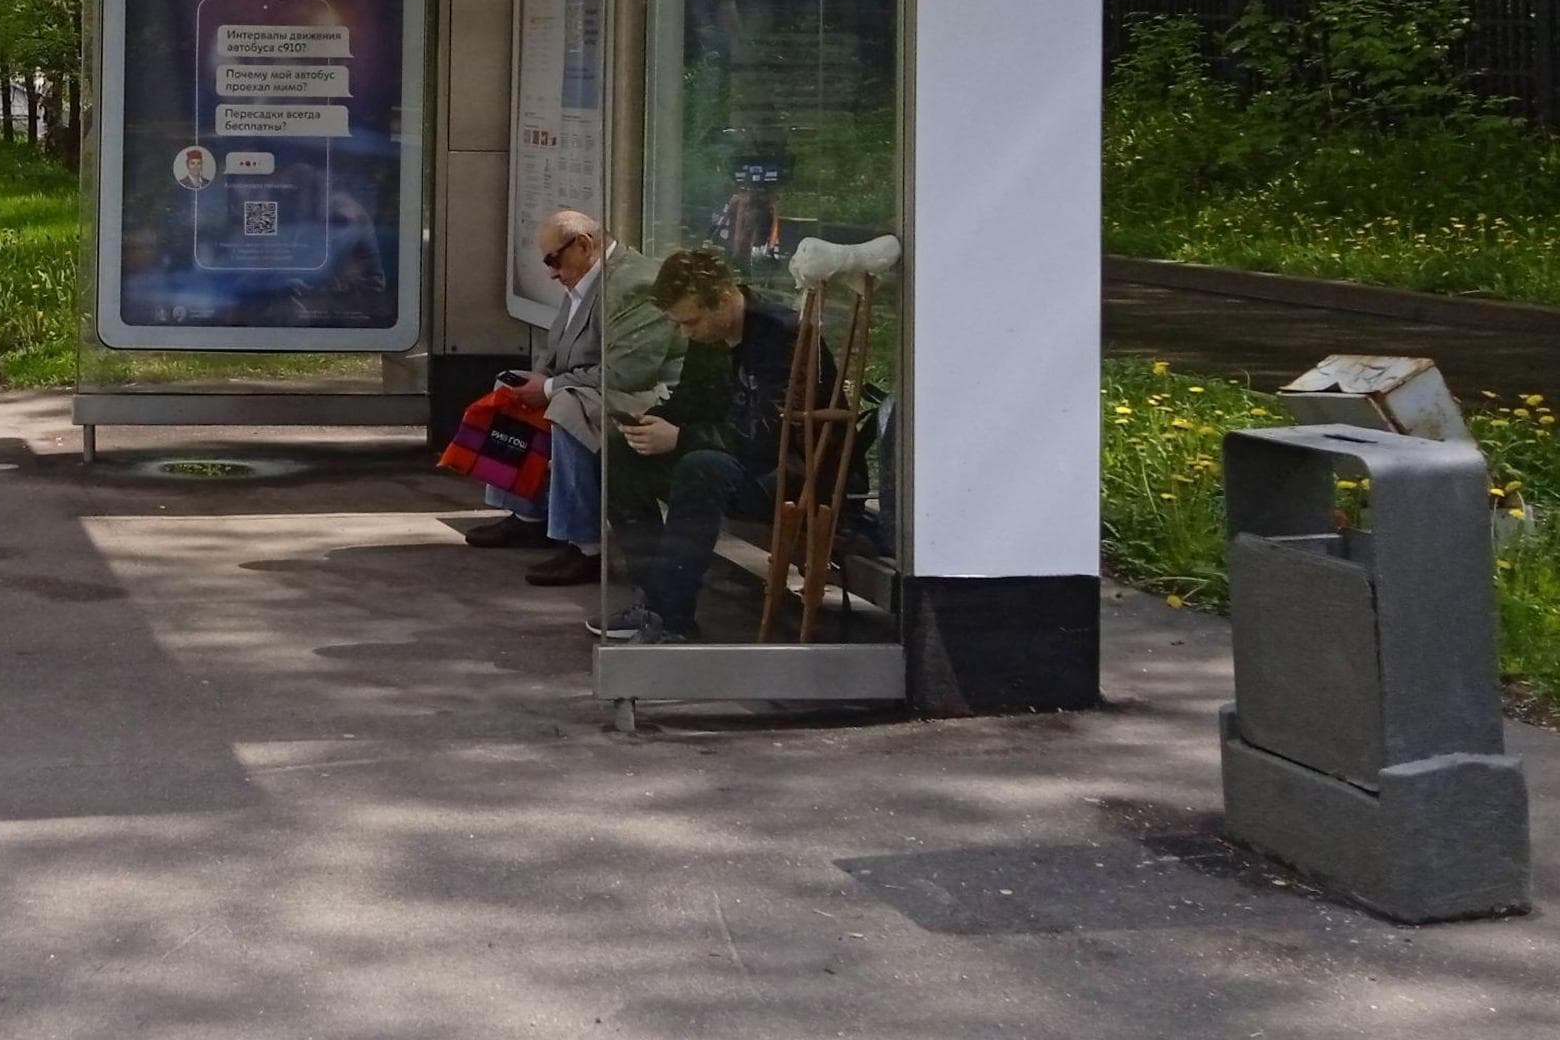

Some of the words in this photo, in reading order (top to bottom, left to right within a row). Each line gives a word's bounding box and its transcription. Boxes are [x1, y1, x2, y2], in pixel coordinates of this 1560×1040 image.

[226, 30, 288, 41] Интервалы
[289, 32, 342, 41] движения
[226, 43, 275, 54] автобуса
[225, 69, 267, 80] Почему
[270, 69, 291, 79] мой
[294, 69, 336, 81] автобус
[225, 83, 271, 93] проехал
[273, 82, 307, 92] мимо?
[224, 109, 284, 120] Пересадки
[286, 111, 321, 121] всегда
[224, 121, 287, 131] бесплатны?
